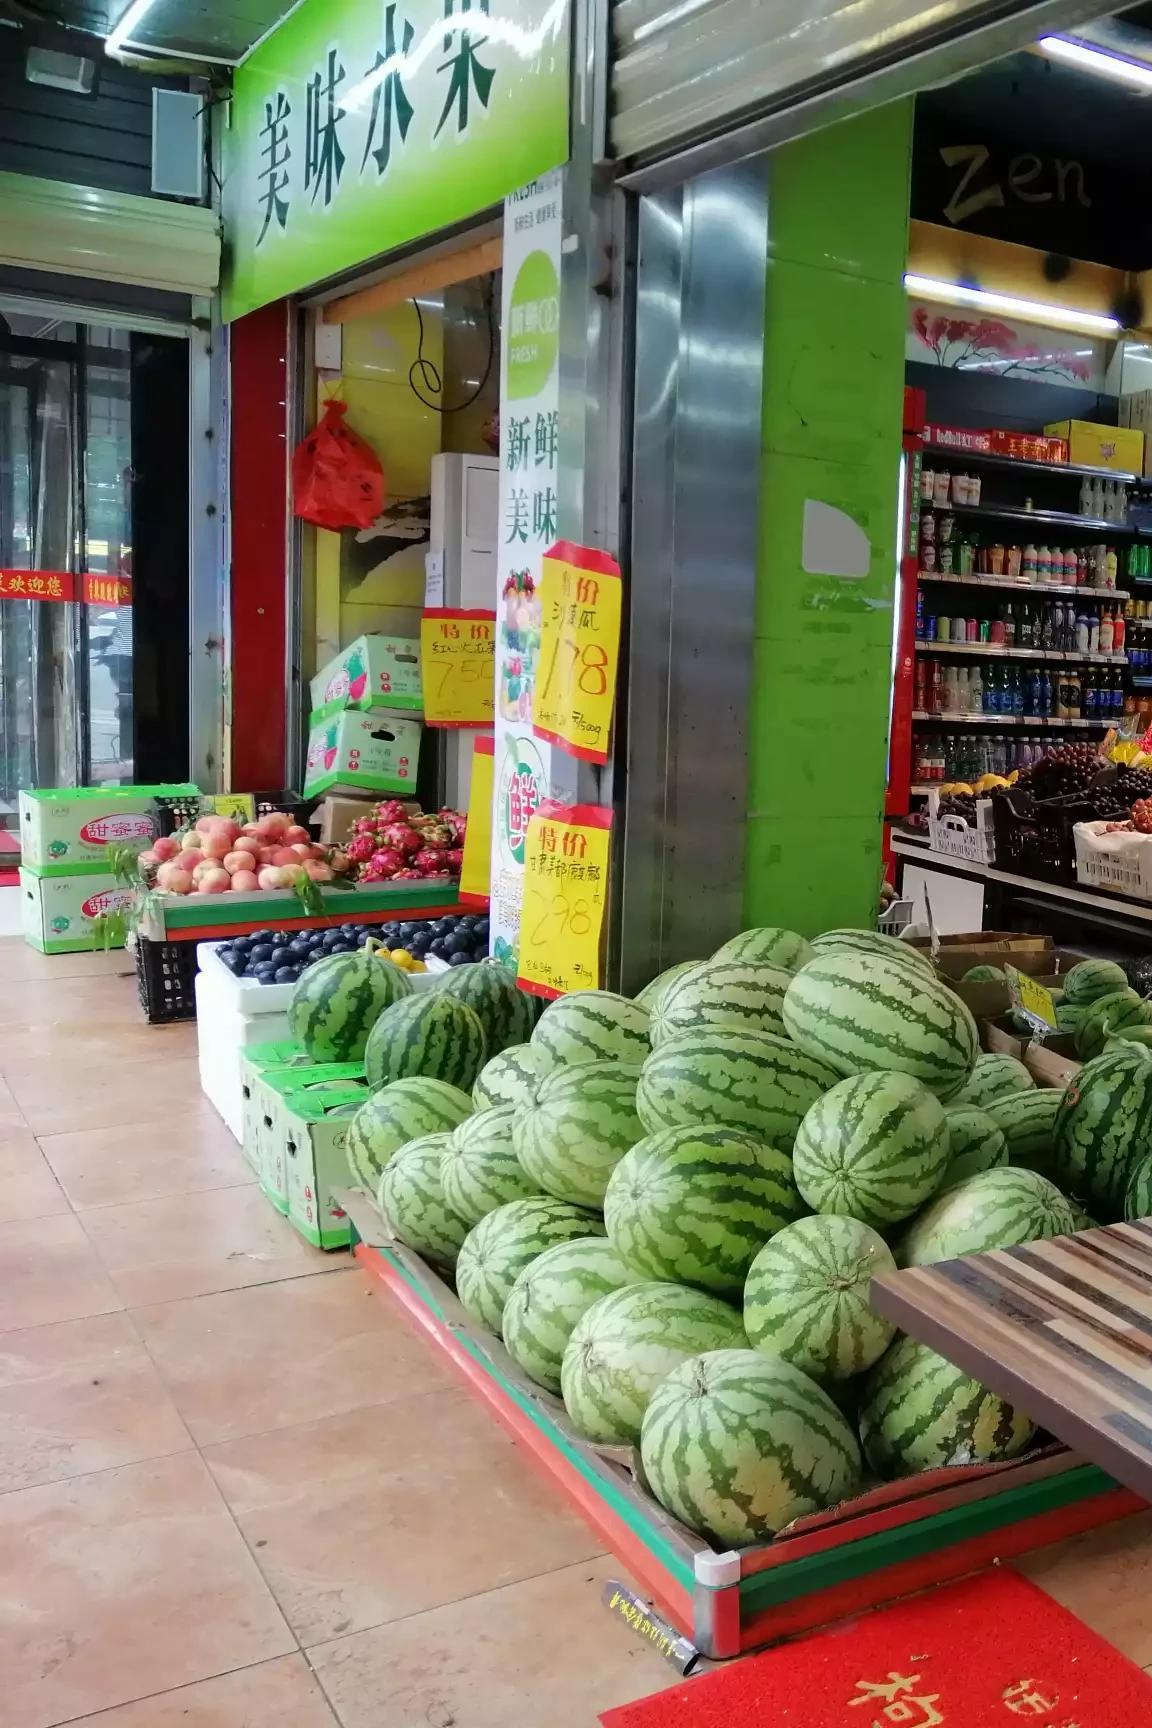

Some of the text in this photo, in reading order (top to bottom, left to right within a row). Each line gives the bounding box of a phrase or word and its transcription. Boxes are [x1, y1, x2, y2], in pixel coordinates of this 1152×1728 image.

[257, 0, 497, 247] 美味水果
[939, 144, 1090, 224] Zen
[506, 410, 558, 471] 新鲜
[505, 487, 556, 544] 美味
[440, 623, 491, 640] 特价
[87, 822, 154, 838] 甜蜜蜜
[538, 826, 588, 859] 特价
